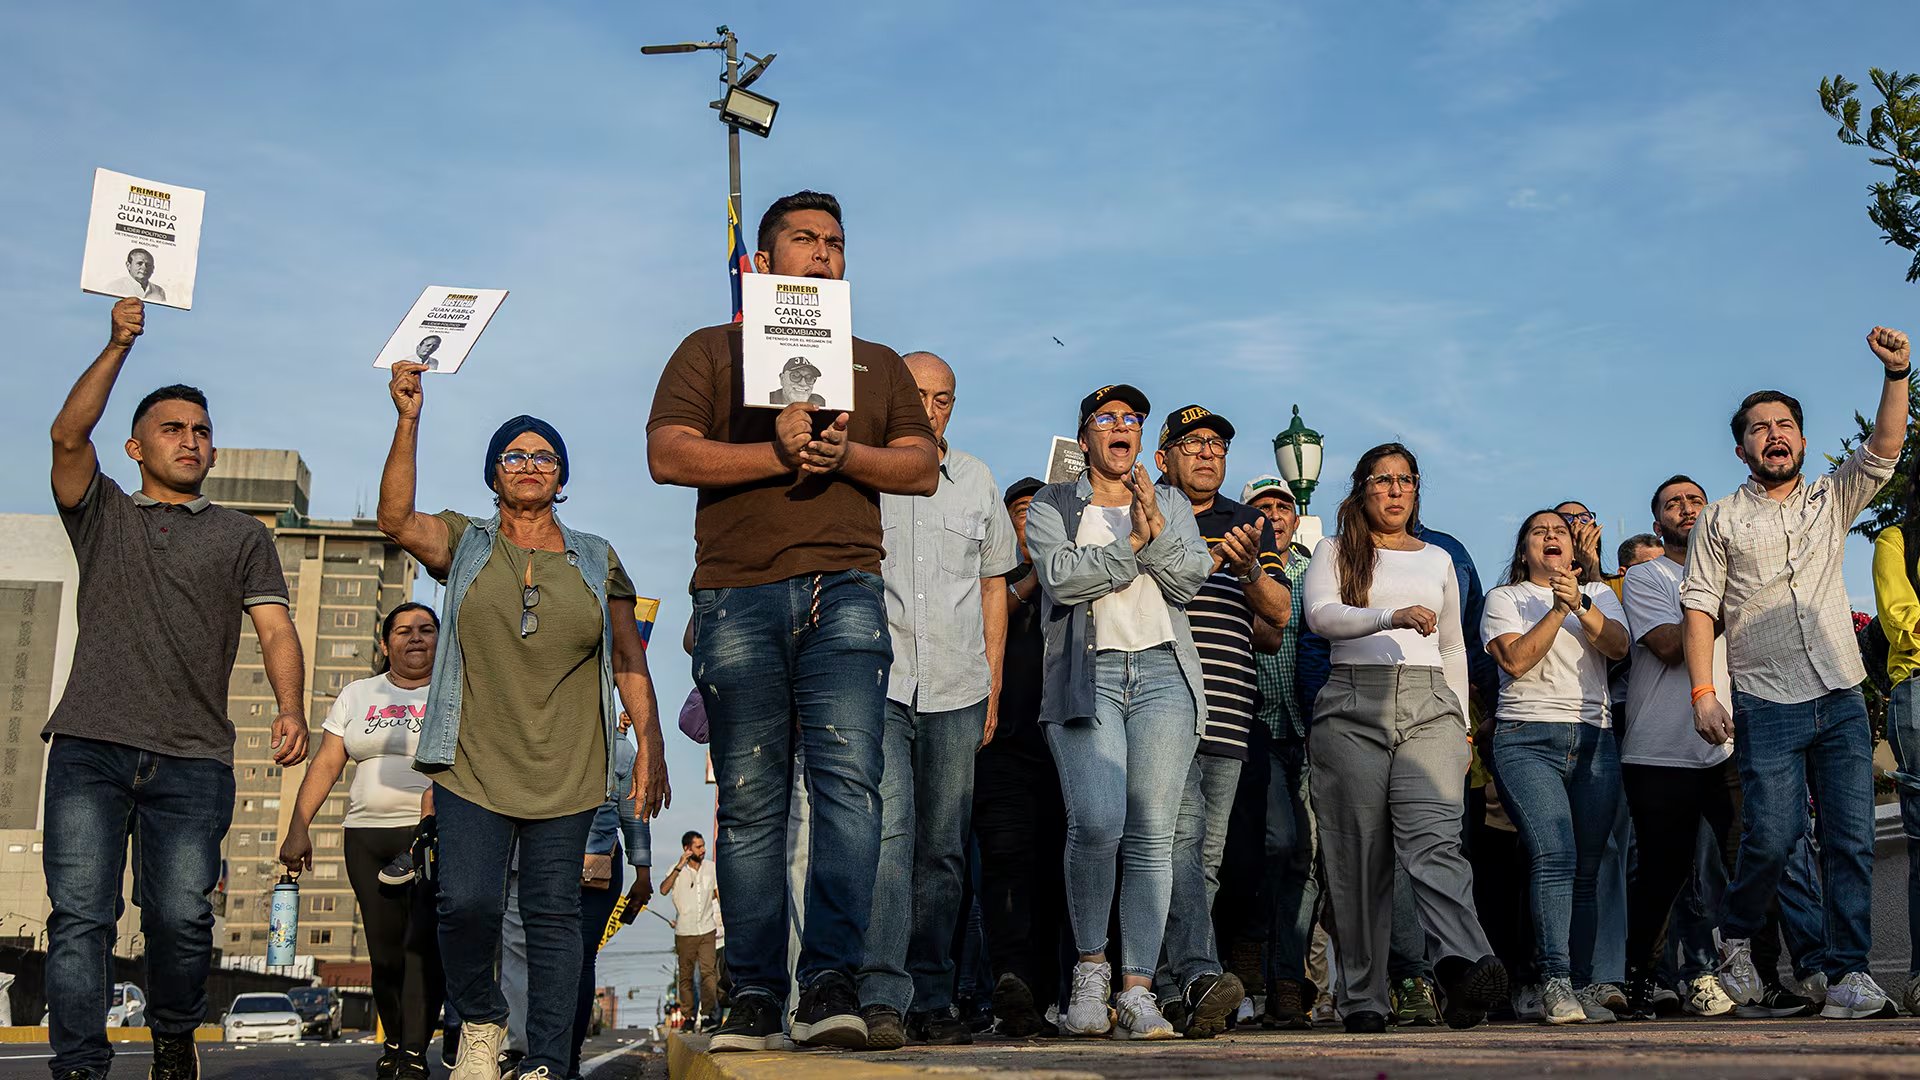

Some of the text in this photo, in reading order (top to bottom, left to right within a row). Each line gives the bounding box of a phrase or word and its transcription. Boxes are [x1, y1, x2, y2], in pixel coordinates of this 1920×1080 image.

[130, 186, 171, 200] PRIMERO
[128, 192, 171, 211] JUSTICIA
[118, 204, 178, 222] JUAN PABLO
[117, 212, 176, 231] GUANIPA
[776, 284, 818, 294] PRIMERO
[776, 292, 819, 307] JUSTICIA
[427, 312, 471, 321] GUANIPA
[774, 307, 821, 317] CARLOS
[779, 315, 817, 327] CAÑAS
[769, 327, 827, 337] COLOMBIANO
[364, 703, 427, 721] LOV
